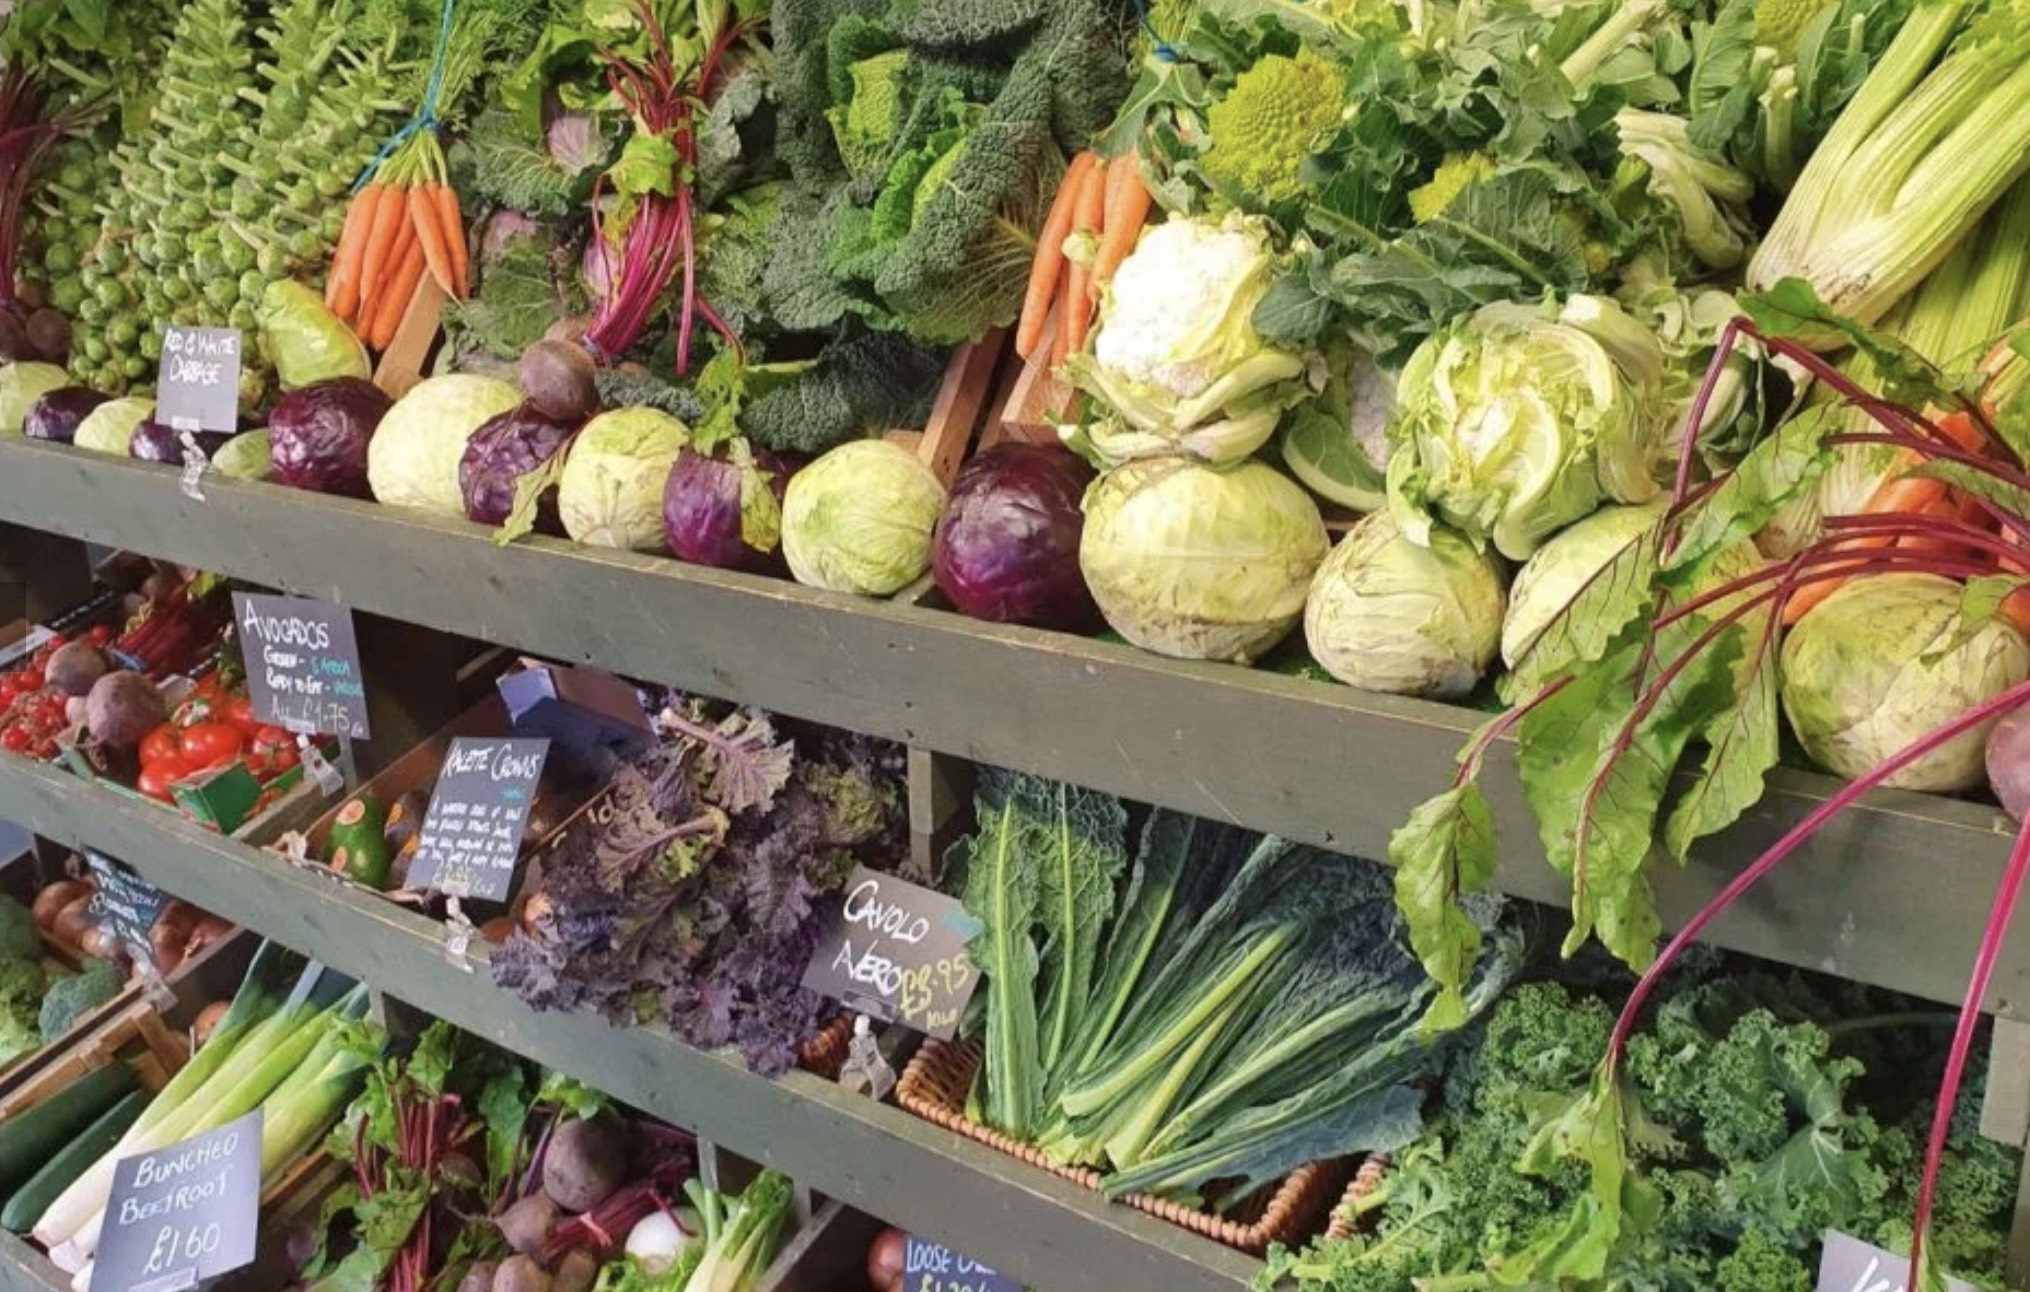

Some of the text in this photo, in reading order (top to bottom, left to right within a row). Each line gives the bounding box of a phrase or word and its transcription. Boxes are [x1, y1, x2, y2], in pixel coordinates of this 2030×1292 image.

[244, 598, 330, 650] AVOCADOS
[843, 880, 930, 943] CAVOLO
[832, 939, 902, 996] NERO
[132, 1132, 239, 1188] BUNCHED
[118, 1163, 234, 1226] BEETROOT
[905, 1237, 951, 1275] LOOSE
